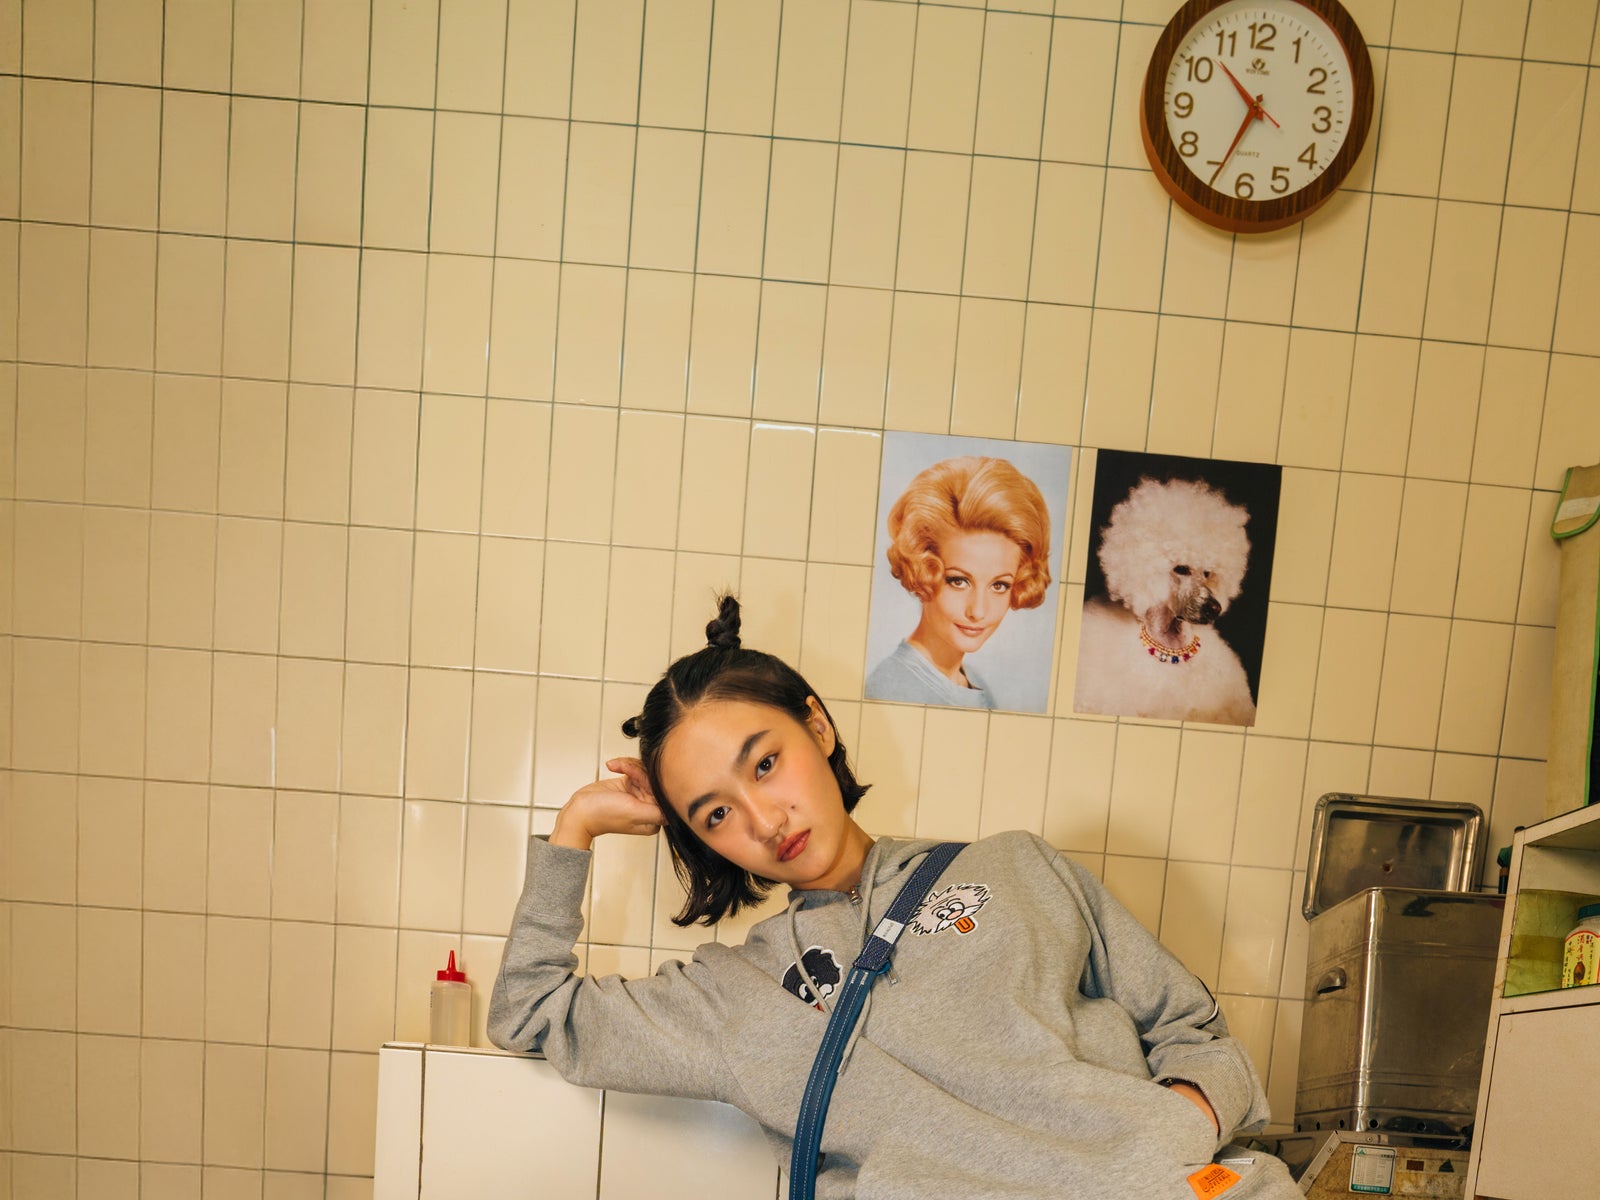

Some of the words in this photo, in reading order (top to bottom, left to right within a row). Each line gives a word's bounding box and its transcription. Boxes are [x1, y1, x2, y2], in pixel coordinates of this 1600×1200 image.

[1215, 29, 1237, 57] 11
[1248, 23, 1277, 51] 12
[1292, 37, 1301, 64] 1
[1185, 56, 1214, 83] 10
[1306, 67, 1328, 95] 2
[1174, 92, 1194, 119] 9
[1311, 106, 1332, 134] 3
[1179, 131, 1199, 158] 8
[1297, 142, 1318, 170] 4
[1206, 160, 1224, 187] 7
[1234, 173, 1255, 200] 6
[1270, 166, 1290, 194] 5
